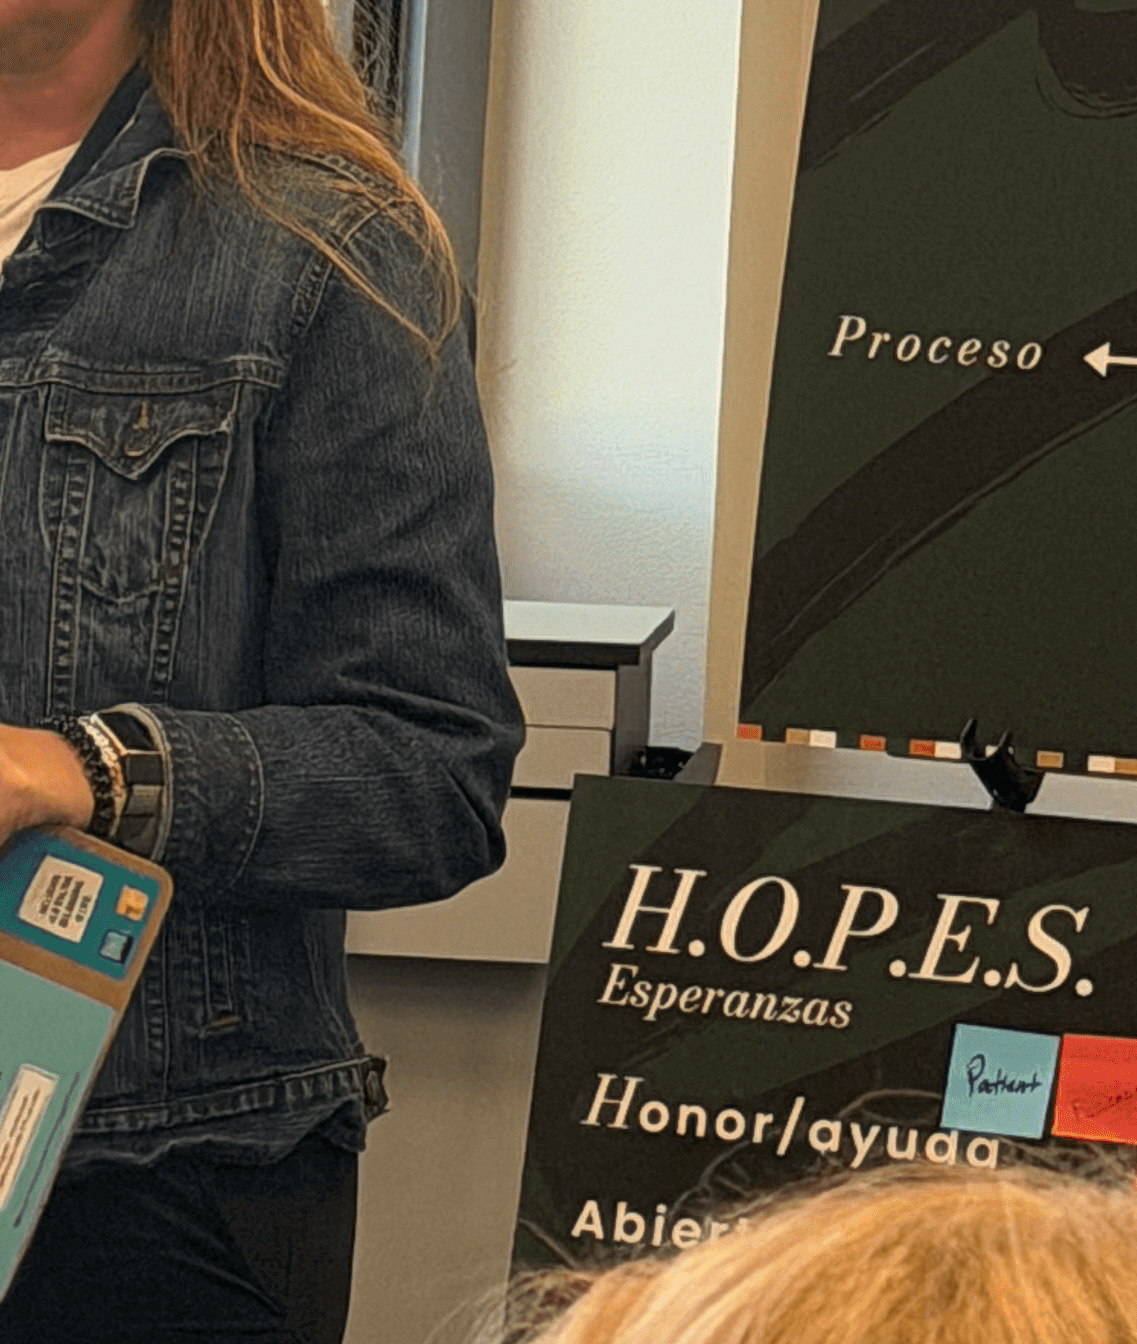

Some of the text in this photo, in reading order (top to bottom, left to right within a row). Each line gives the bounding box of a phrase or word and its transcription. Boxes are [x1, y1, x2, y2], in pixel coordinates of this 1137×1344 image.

[827, 314, 1042, 370] Proceso
[602, 864, 1093, 996] H.O.P.E.S.
[597, 963, 853, 1029] Esperanzas
[580, 1072, 1000, 1169] Honor/ayuda
